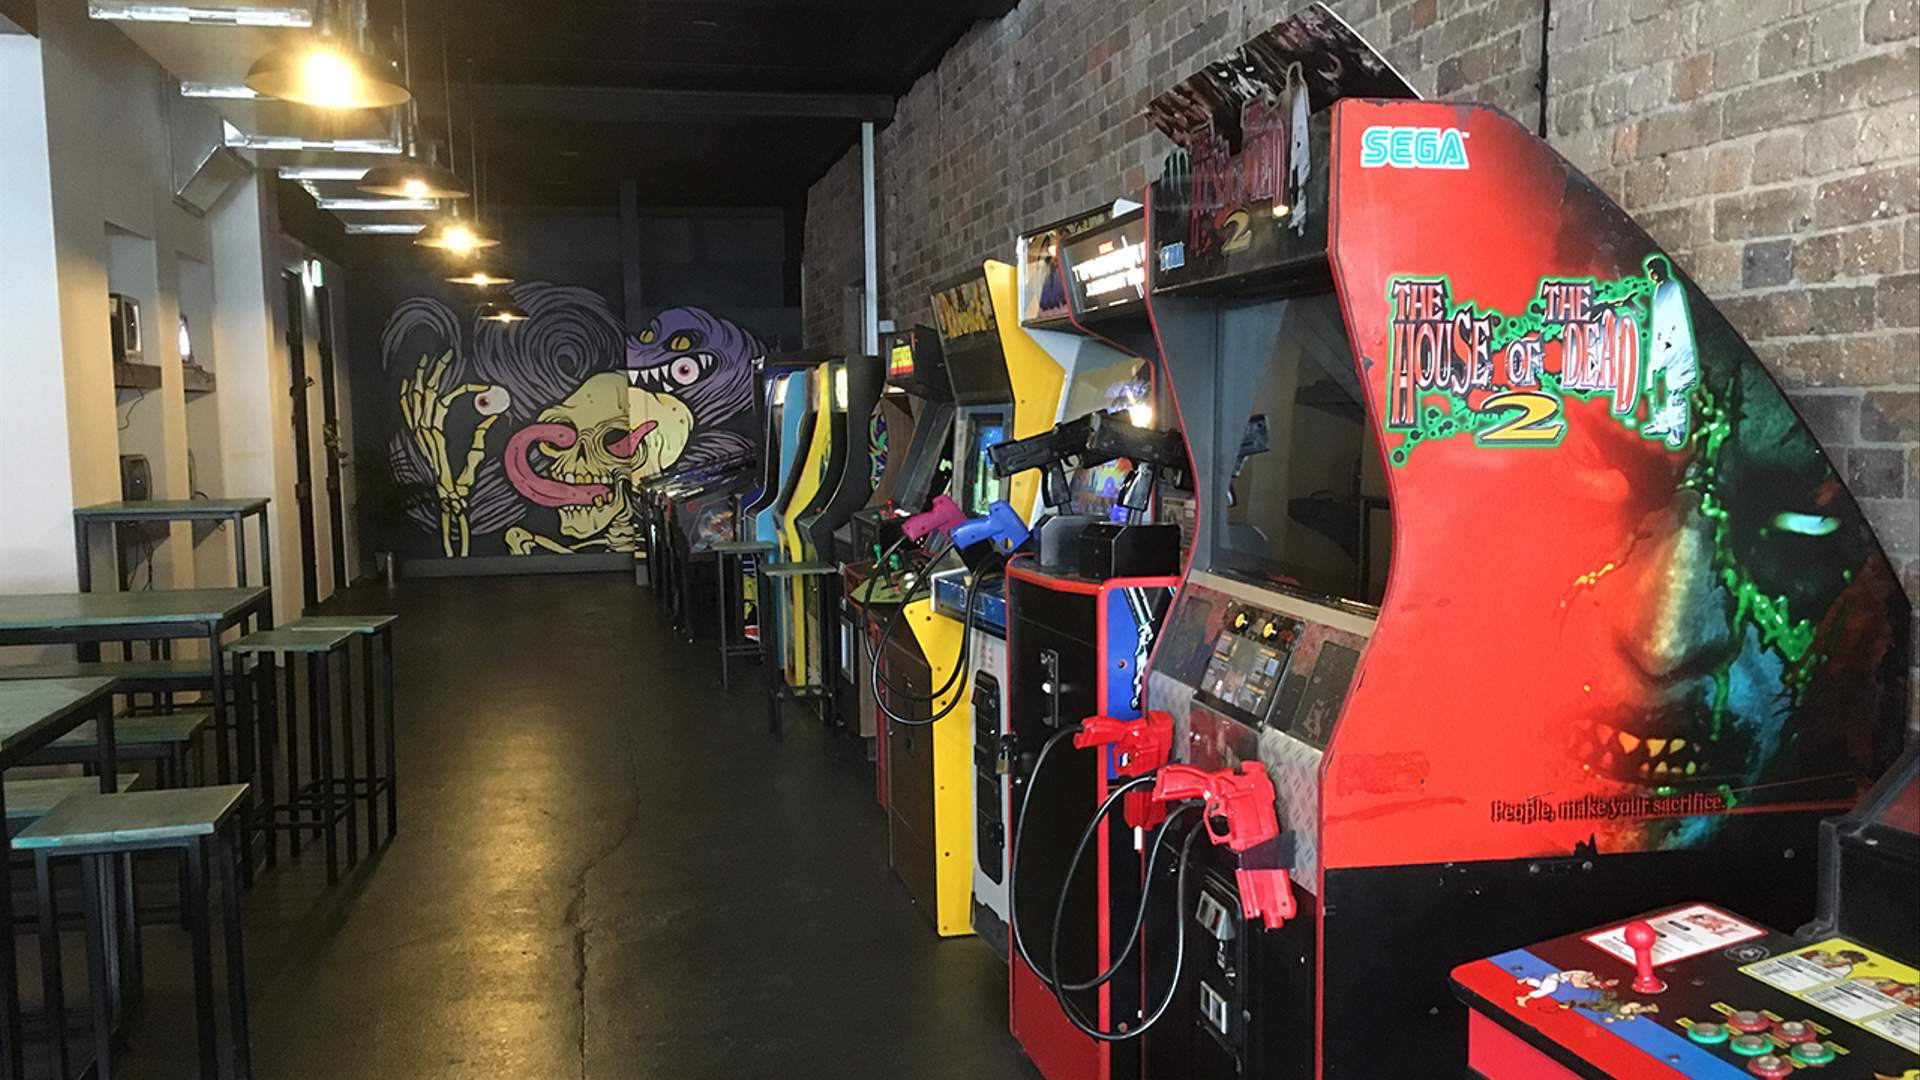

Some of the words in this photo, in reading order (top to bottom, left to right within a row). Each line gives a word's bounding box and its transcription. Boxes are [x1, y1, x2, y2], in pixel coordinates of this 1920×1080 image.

[1360, 126, 1470, 169] SEGA
[1221, 208, 1251, 252] 2
[1392, 280, 1447, 320] THE
[1543, 281, 1595, 322] THE
[1389, 304, 1494, 427] HOUSE
[1507, 335, 1544, 388] OF
[1560, 307, 1640, 415] DEAD
[1478, 391, 1564, 443] 2
[1491, 799, 1556, 824] People,
[1557, 792, 1606, 820] make
[1608, 797, 1648, 819] your
